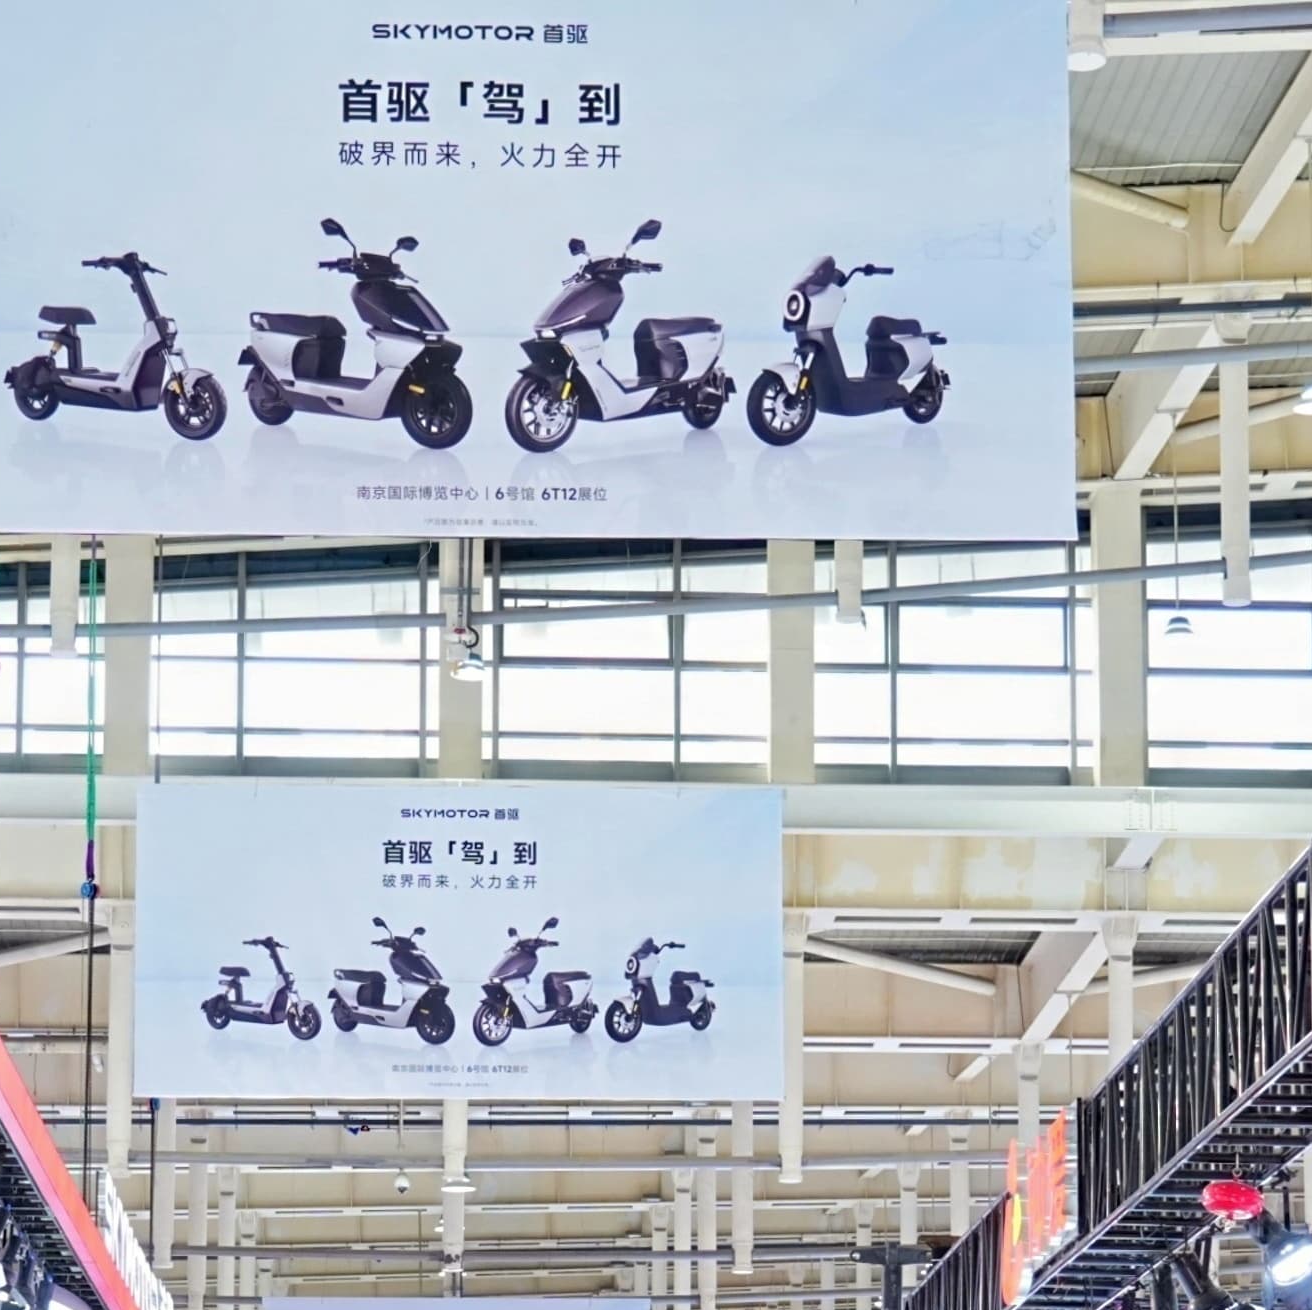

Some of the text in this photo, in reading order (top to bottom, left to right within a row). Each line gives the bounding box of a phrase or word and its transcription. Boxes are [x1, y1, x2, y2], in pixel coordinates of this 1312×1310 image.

[372, 24, 588, 44] SKYMOTOR 首驱
[338, 140, 622, 169] 破界而来，火力全开
[357, 486, 608, 501] 南京国际博览中心 6号馆 6T12展位
[400, 808, 489, 819] SKYMOTOR
